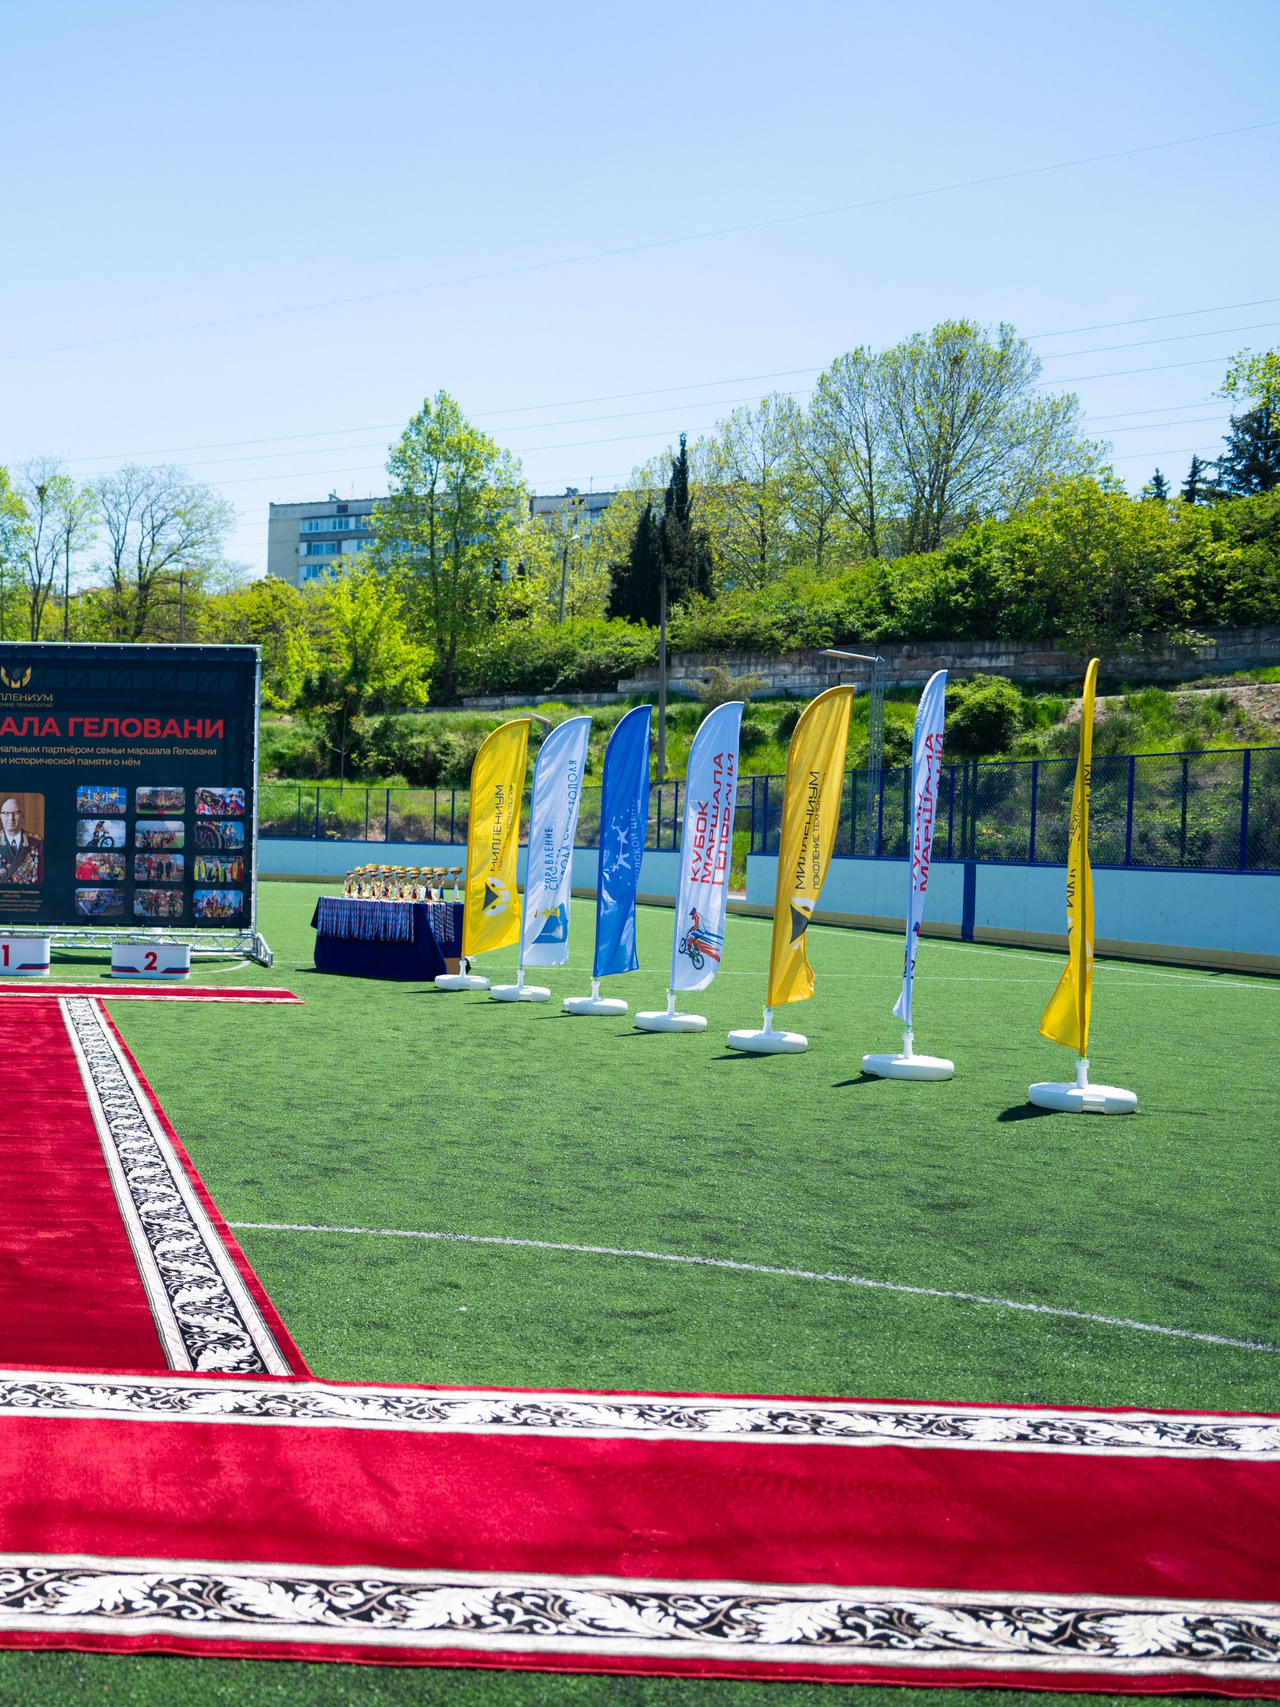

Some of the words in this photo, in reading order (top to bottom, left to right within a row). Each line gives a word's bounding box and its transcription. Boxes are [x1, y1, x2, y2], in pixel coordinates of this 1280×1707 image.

[41, 745, 94, 755] партнёром
[127, 747, 171, 757] маршала
[172, 746, 217, 756] Геловани
[68, 717, 224, 739] ГЕЛОВАНИ
[8, 756, 76, 766] исторической
[77, 757, 112, 766] памяти
[113, 758, 120, 766] о
[121, 757, 141, 767] нём
[490, 784, 505, 872] МИЛЛЕНИУМ
[701, 752, 724, 884] МАРШАЛА
[813, 772, 826, 832] ТЕХНОЛ
[690, 800, 709, 882] КУБОК
[795, 771, 820, 890] МИЛЛЕНИУМ
[630, 832, 641, 885] ОДСКОЙ
[813, 834, 821, 890] ПОКОЛЕНИЕ
[1, 944, 10, 967] 1
[143, 951, 159, 971] 2
